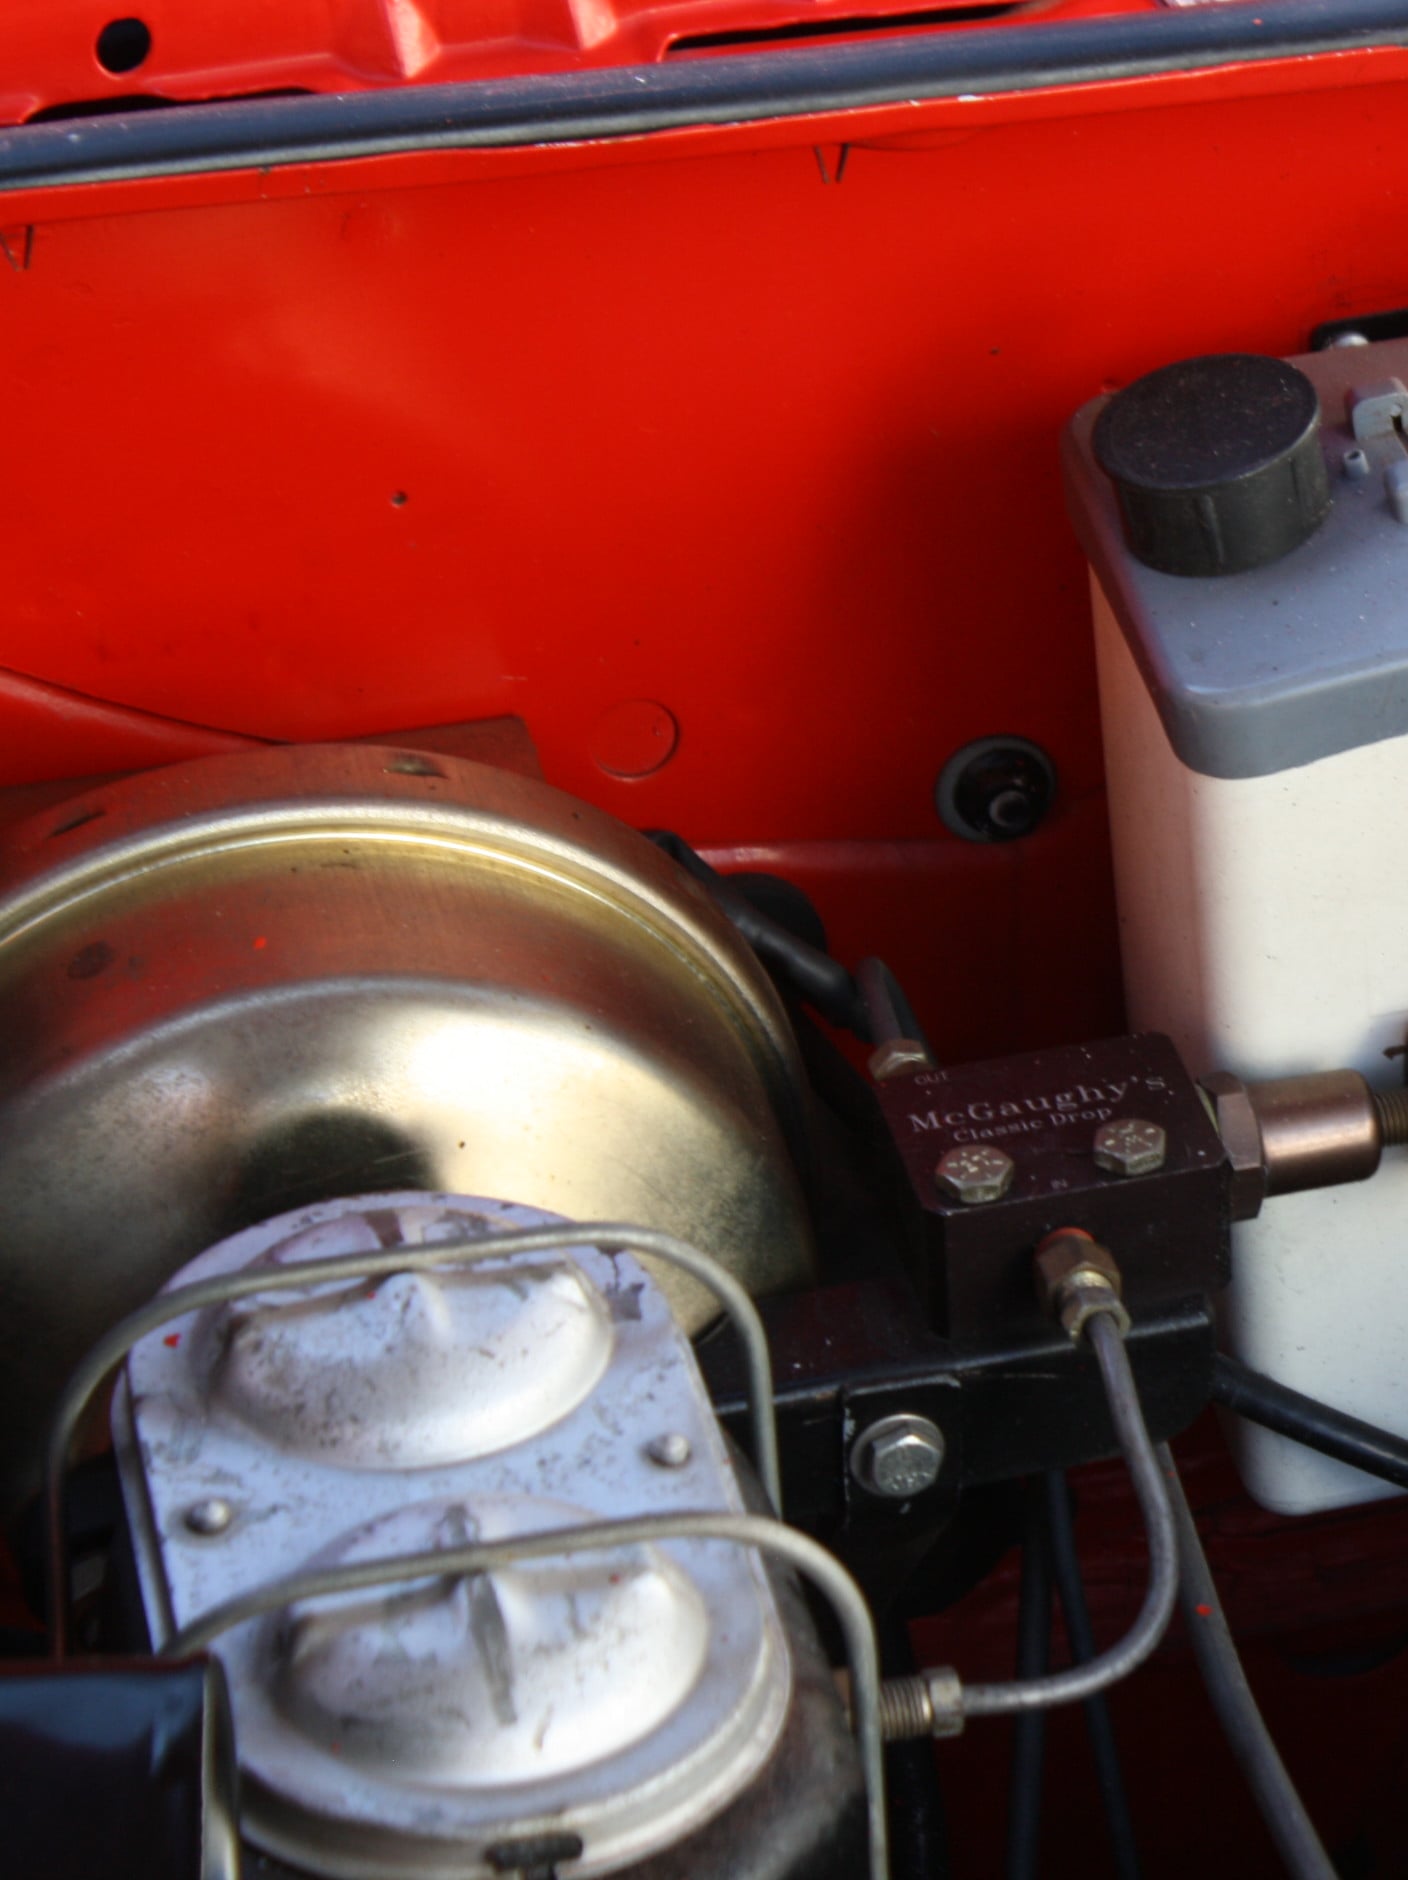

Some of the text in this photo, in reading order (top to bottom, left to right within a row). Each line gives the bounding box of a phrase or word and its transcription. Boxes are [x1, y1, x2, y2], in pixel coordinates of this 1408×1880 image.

[914, 1070, 949, 1087] OUT
[907, 1074, 1167, 1134] McGaughy's
[952, 1108, 1114, 1143] Classic Drop
